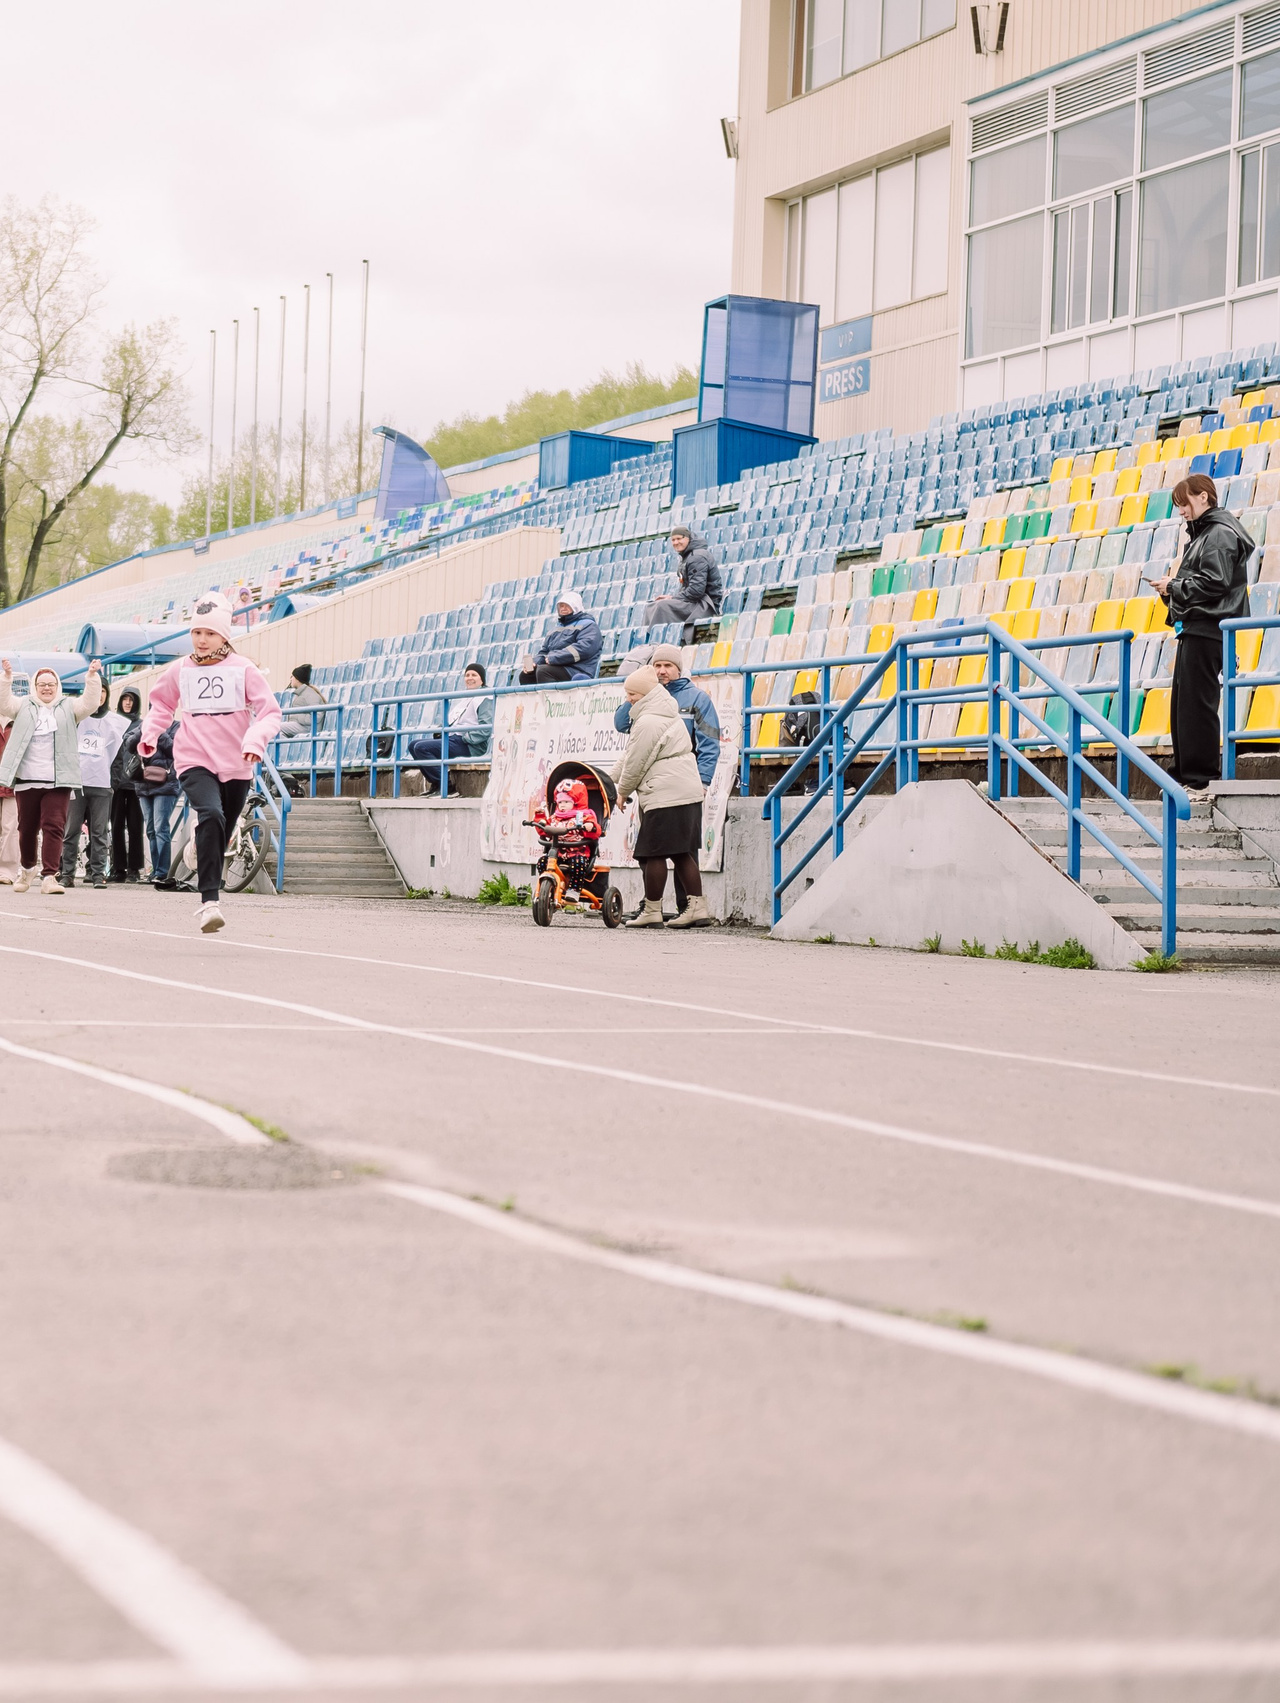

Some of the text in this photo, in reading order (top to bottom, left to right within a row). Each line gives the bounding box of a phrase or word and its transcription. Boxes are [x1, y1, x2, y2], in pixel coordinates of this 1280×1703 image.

[838, 331, 854, 348] VIP
[825, 366, 864, 397] PRESS
[197, 676, 224, 699] 26
[34, 718, 50, 732] 21
[83, 738, 98, 750] 34
